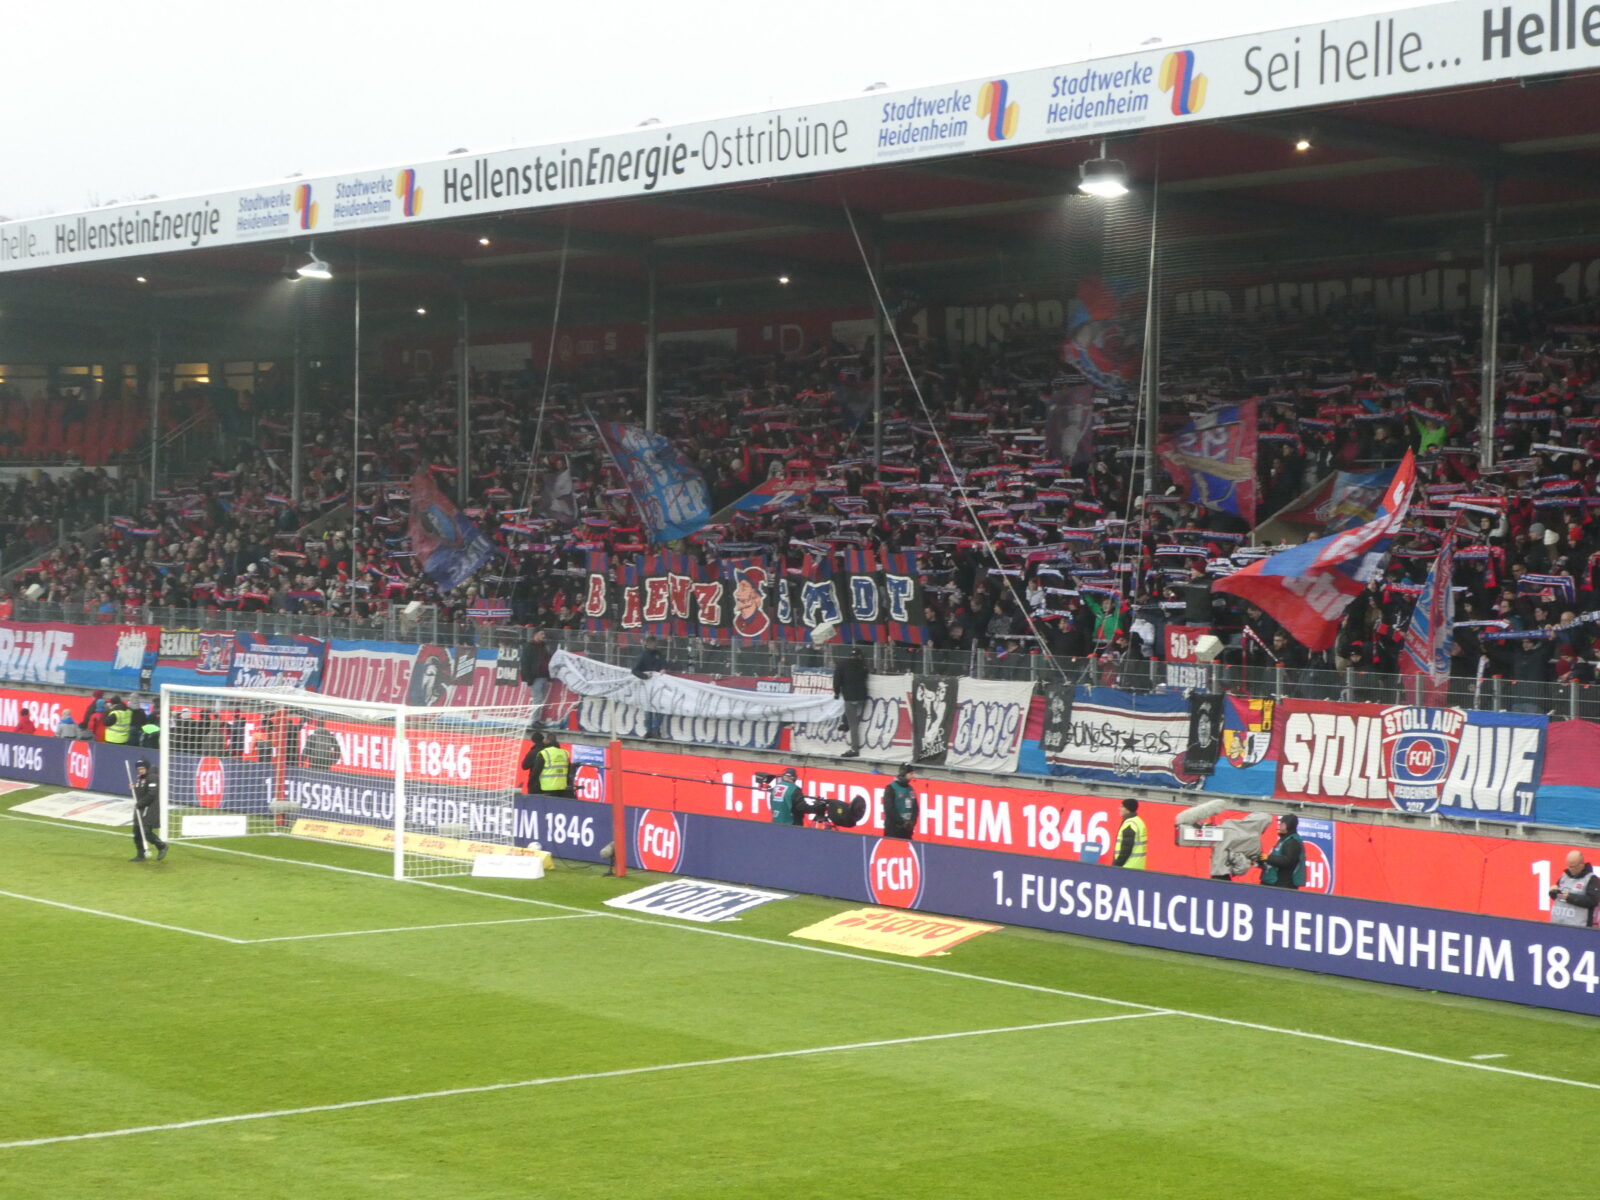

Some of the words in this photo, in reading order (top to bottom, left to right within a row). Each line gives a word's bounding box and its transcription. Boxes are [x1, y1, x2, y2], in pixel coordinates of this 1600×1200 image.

[1243, 36, 1301, 96] Sei
[1319, 18, 1462, 86] helle...
[1050, 61, 1153, 98] Stadtwerke
[881, 89, 971, 123] Stadtwerke
[1047, 91, 1149, 125] Heidenheim
[877, 118, 968, 148] Heidenheim
[443, 115, 849, 204] HellensteinEnergie-Osttribüne
[237, 191, 292, 214] Stadtwerke
[335, 175, 393, 200] Stadtwerke
[236, 206, 290, 232] Heidenheim
[333, 197, 392, 220] Heidenheim
[55, 200, 220, 254] HellensteinEnergie
[1384, 708, 1429, 735] STOLL
[1431, 709, 1463, 735] AUF
[12, 744, 43, 772] 1846
[68, 752, 90, 779] FCH
[416, 739, 472, 780] 1846
[1282, 711, 1388, 800] STOLL
[1440, 724, 1541, 813] AUF
[1408, 750, 1432, 767] FCH
[199, 771, 222, 796] FCH
[411, 798, 538, 841] HEIDENHEIM
[545, 812, 595, 848] 1846
[643, 823, 676, 861] FCH
[721, 771, 744, 813] 1.
[1022, 803, 1112, 857] 1846
[876, 856, 914, 892] FCH
[992, 869, 1012, 906] 1.
[1020, 872, 1254, 943] FUSSBALLCLUB
[1265, 906, 1515, 982] HEIDENHEIM
